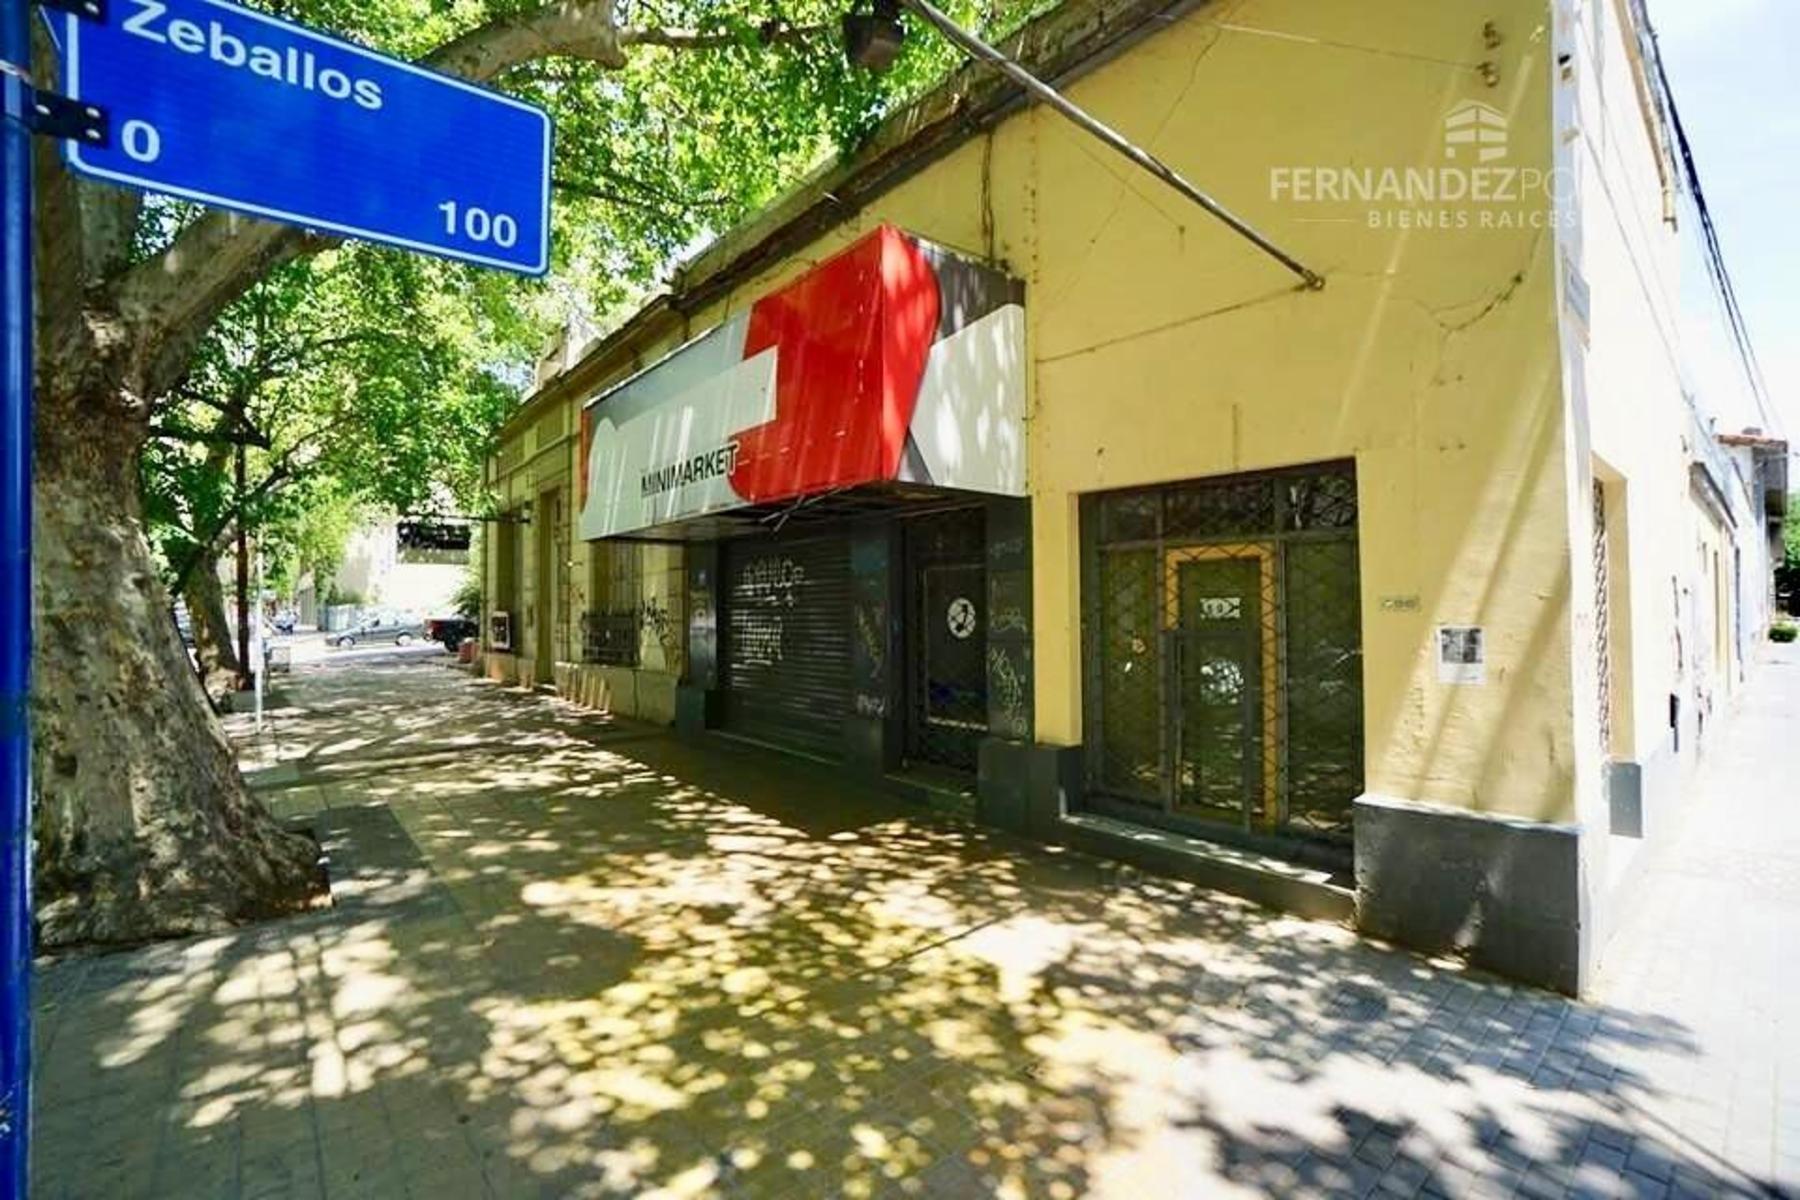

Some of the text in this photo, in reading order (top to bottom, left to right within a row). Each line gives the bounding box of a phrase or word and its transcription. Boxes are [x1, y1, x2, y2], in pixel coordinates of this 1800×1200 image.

[122, 0, 383, 110] Zeballos
[438, 200, 518, 249] 100
[641, 440, 740, 498] MINIMARKET
